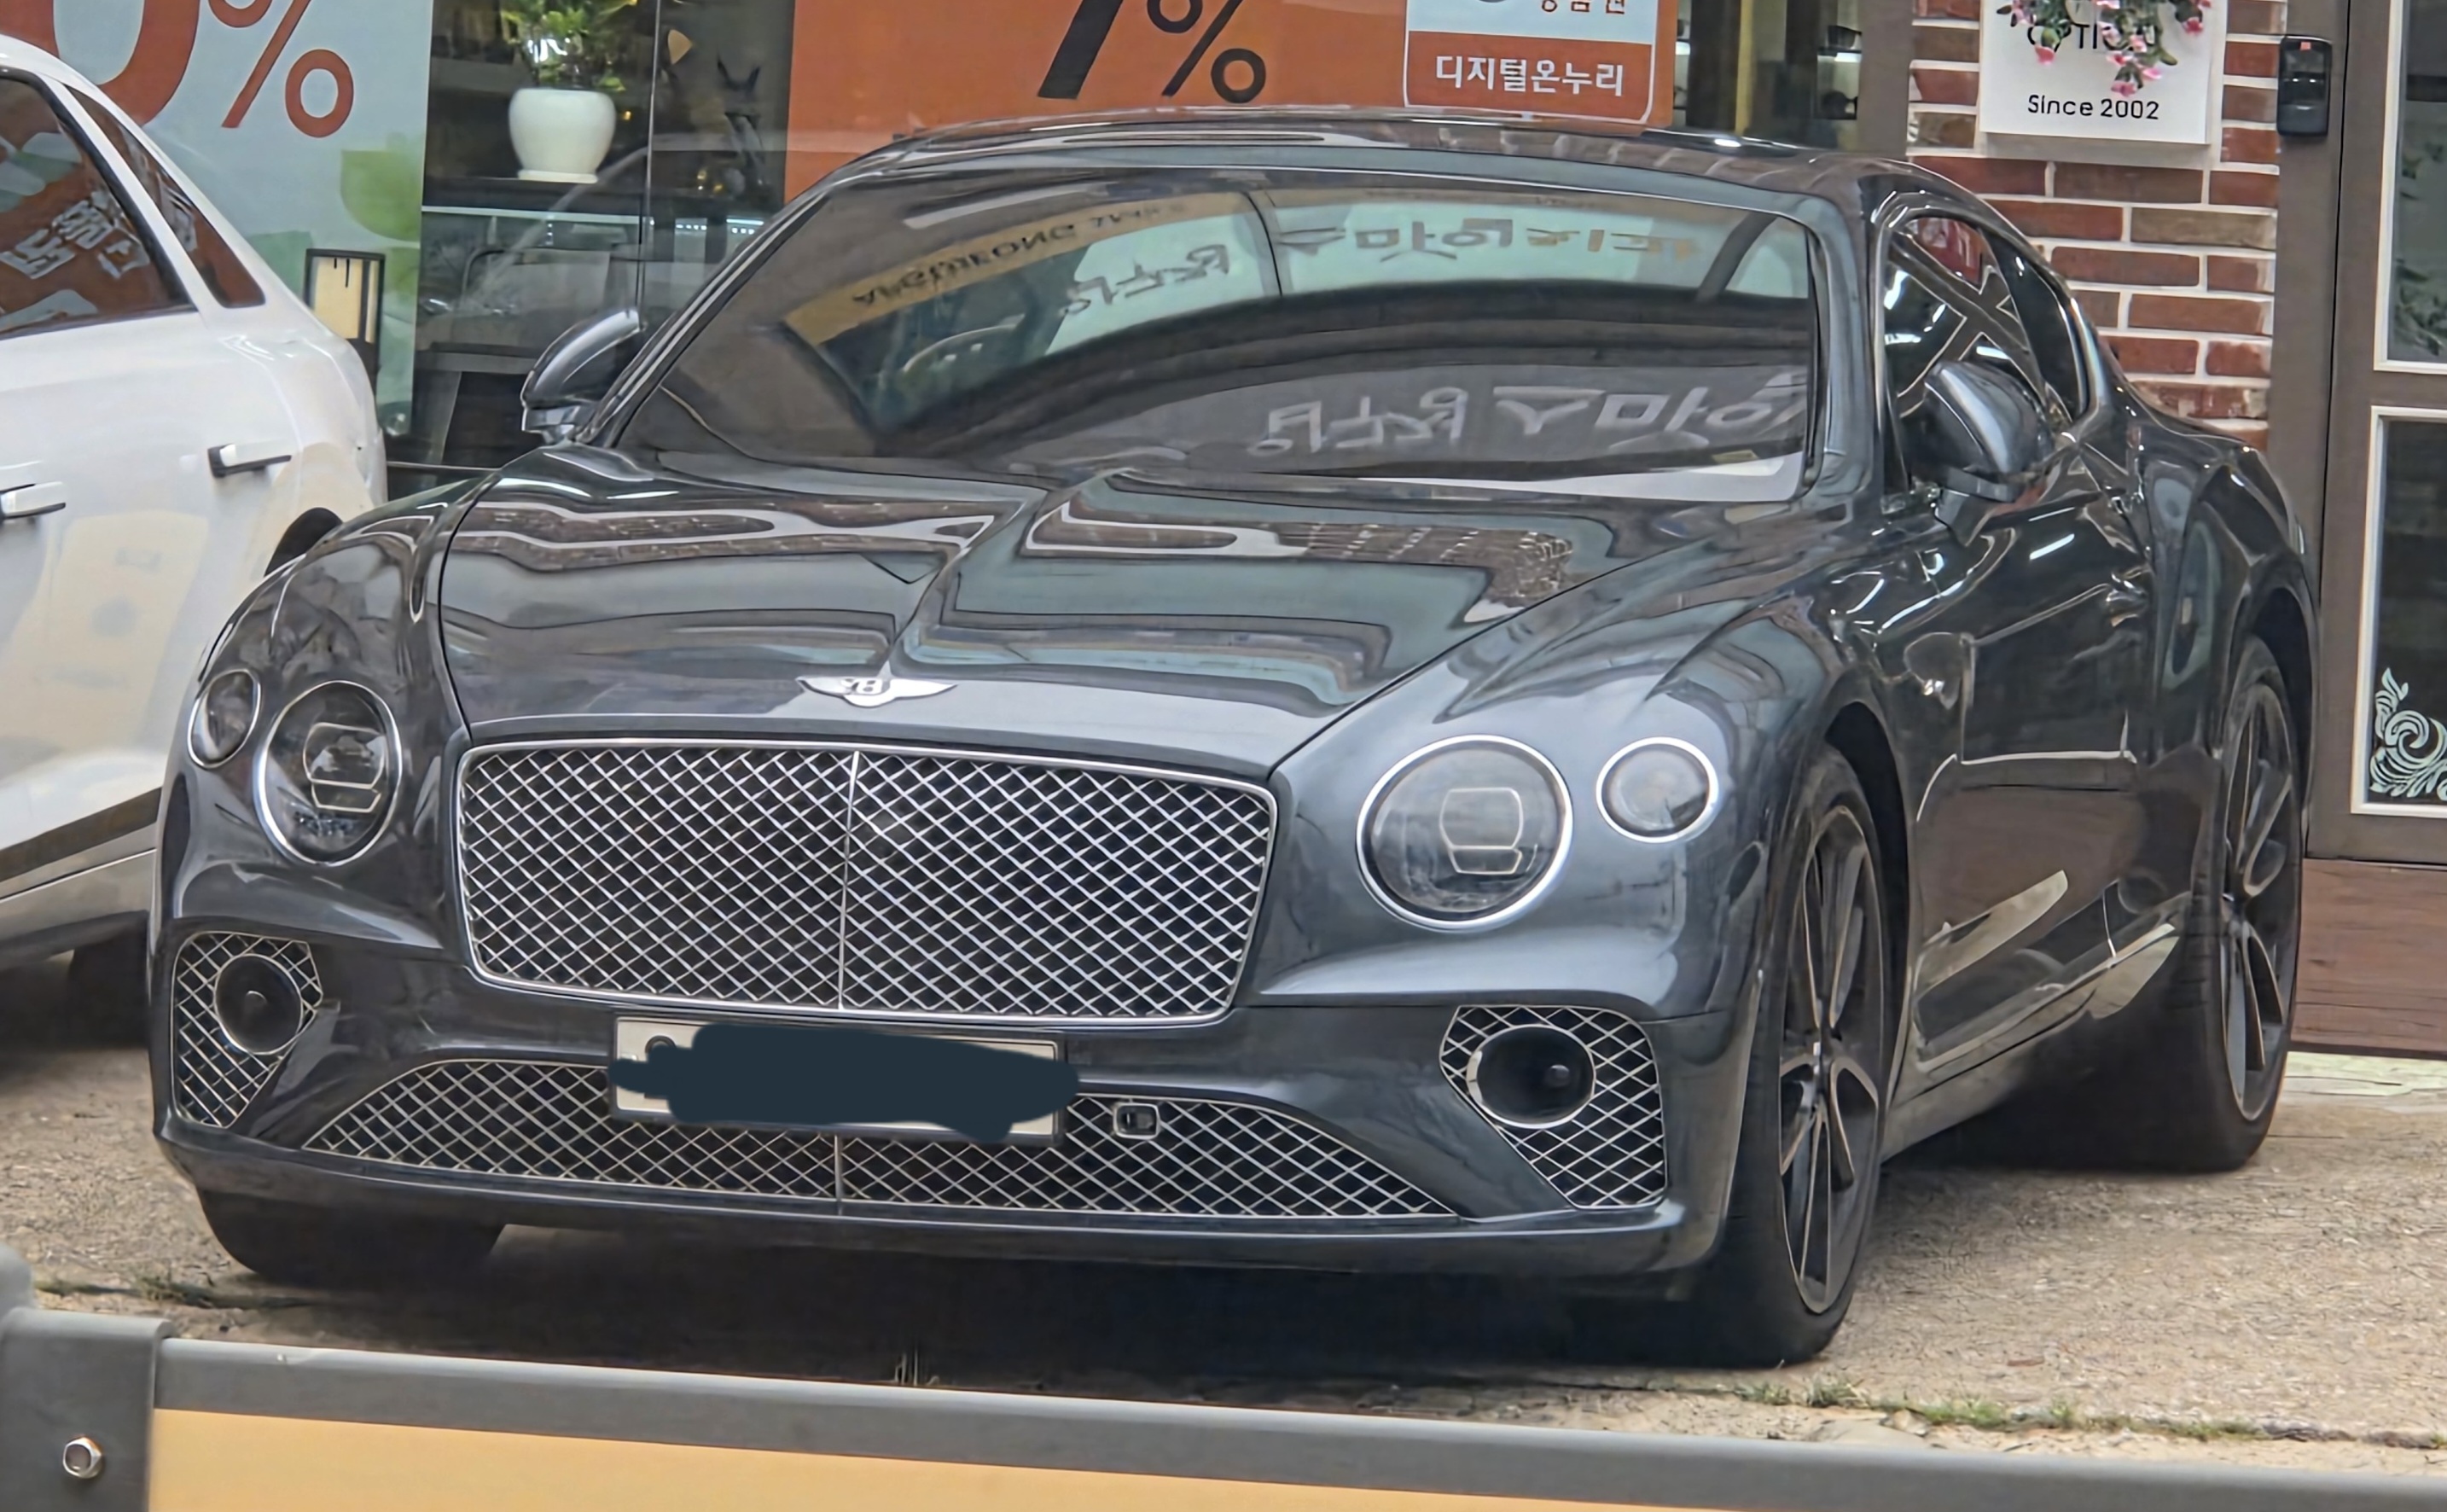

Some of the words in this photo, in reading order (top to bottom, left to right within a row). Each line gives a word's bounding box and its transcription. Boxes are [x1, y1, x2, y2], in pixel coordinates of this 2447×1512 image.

[1435, 55, 1624, 96] 디지털온누리
[2027, 94, 2094, 116] Since
[2100, 98, 2159, 119] 2002
